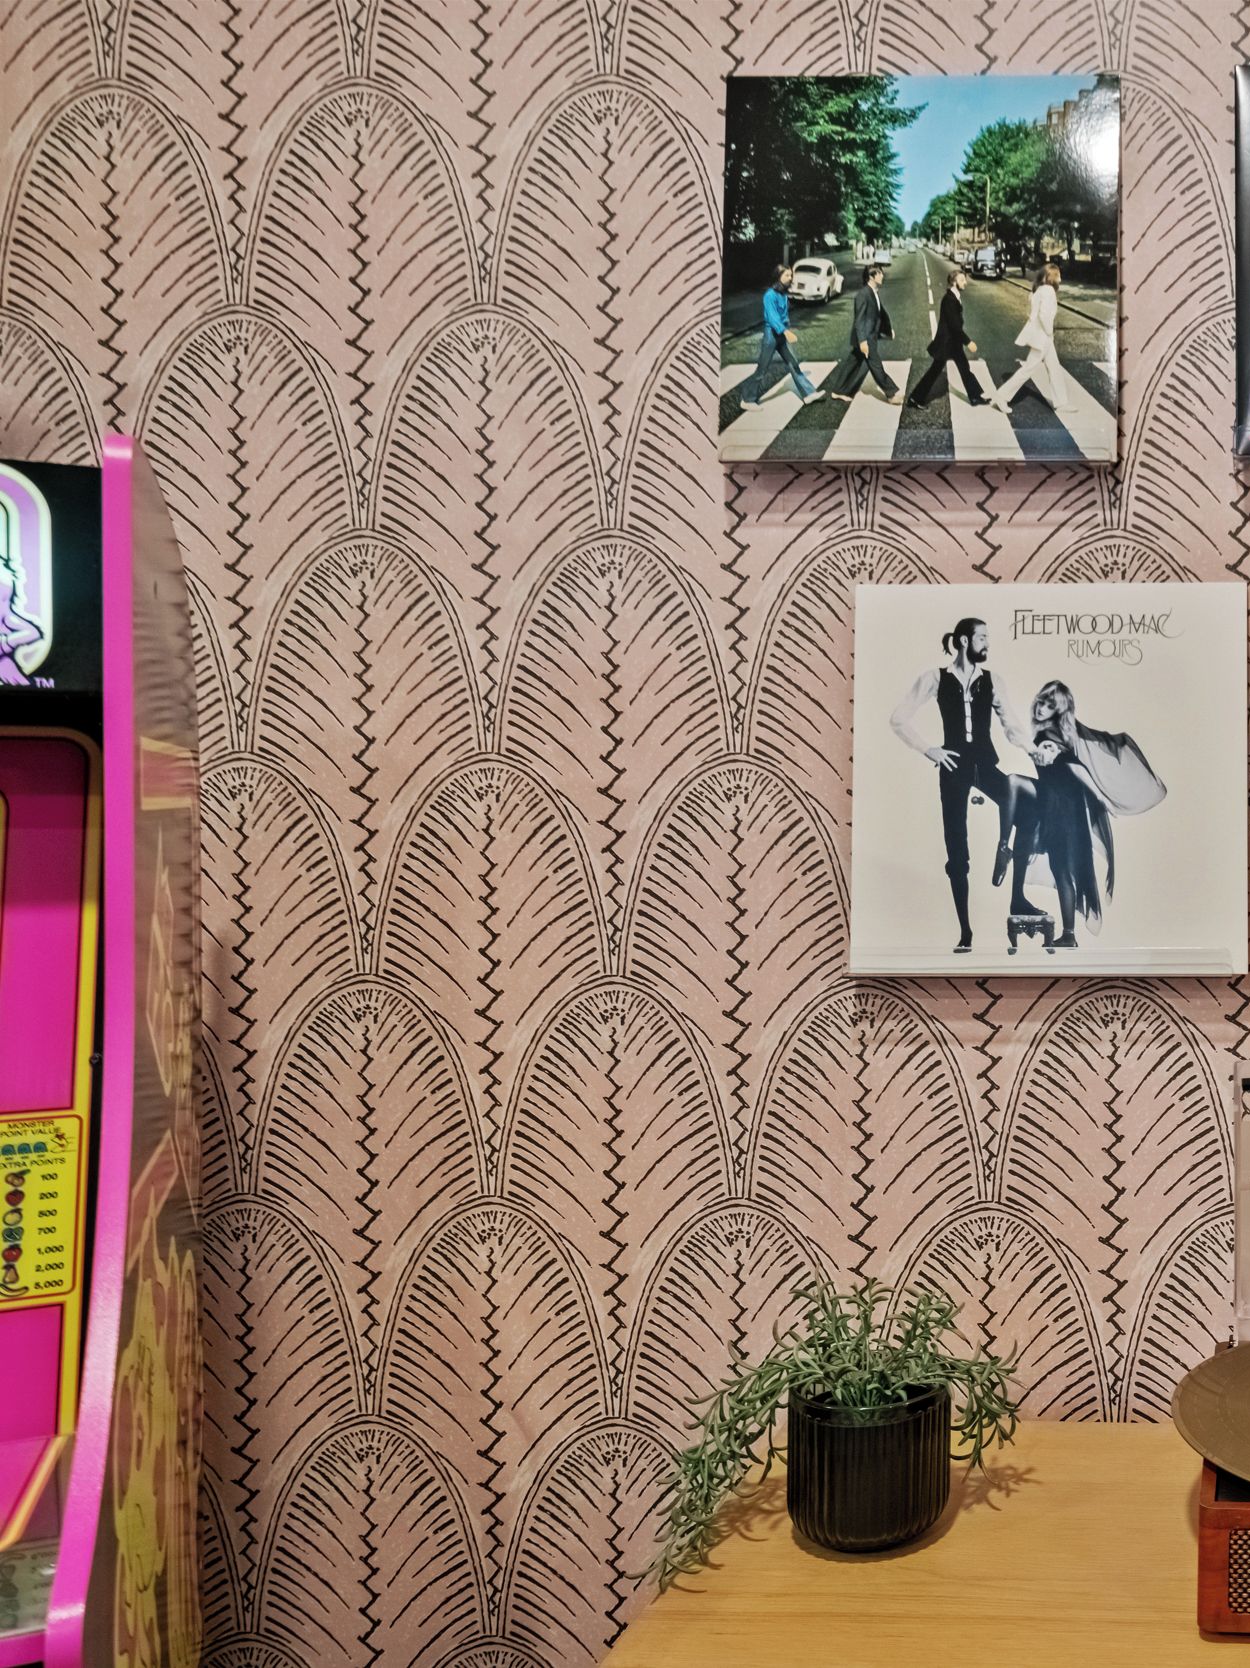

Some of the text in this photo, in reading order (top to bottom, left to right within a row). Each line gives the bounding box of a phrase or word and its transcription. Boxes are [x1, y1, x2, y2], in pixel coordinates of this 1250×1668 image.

[1010, 607, 1185, 640] FLEETWOOD MAC
[1067, 638, 1143, 666] RUMOURS
[33, 676, 55, 689] TM
[8, 1120, 55, 1129] MONSTER
[31, 1126, 61, 1135] VALUE
[0, 1161, 28, 1169] XTRA
[30, 1157, 66, 1166] POINTS
[41, 1172, 58, 1181] 100
[39, 1191, 58, 1200] 200
[37, 1226, 57, 1235] 700
